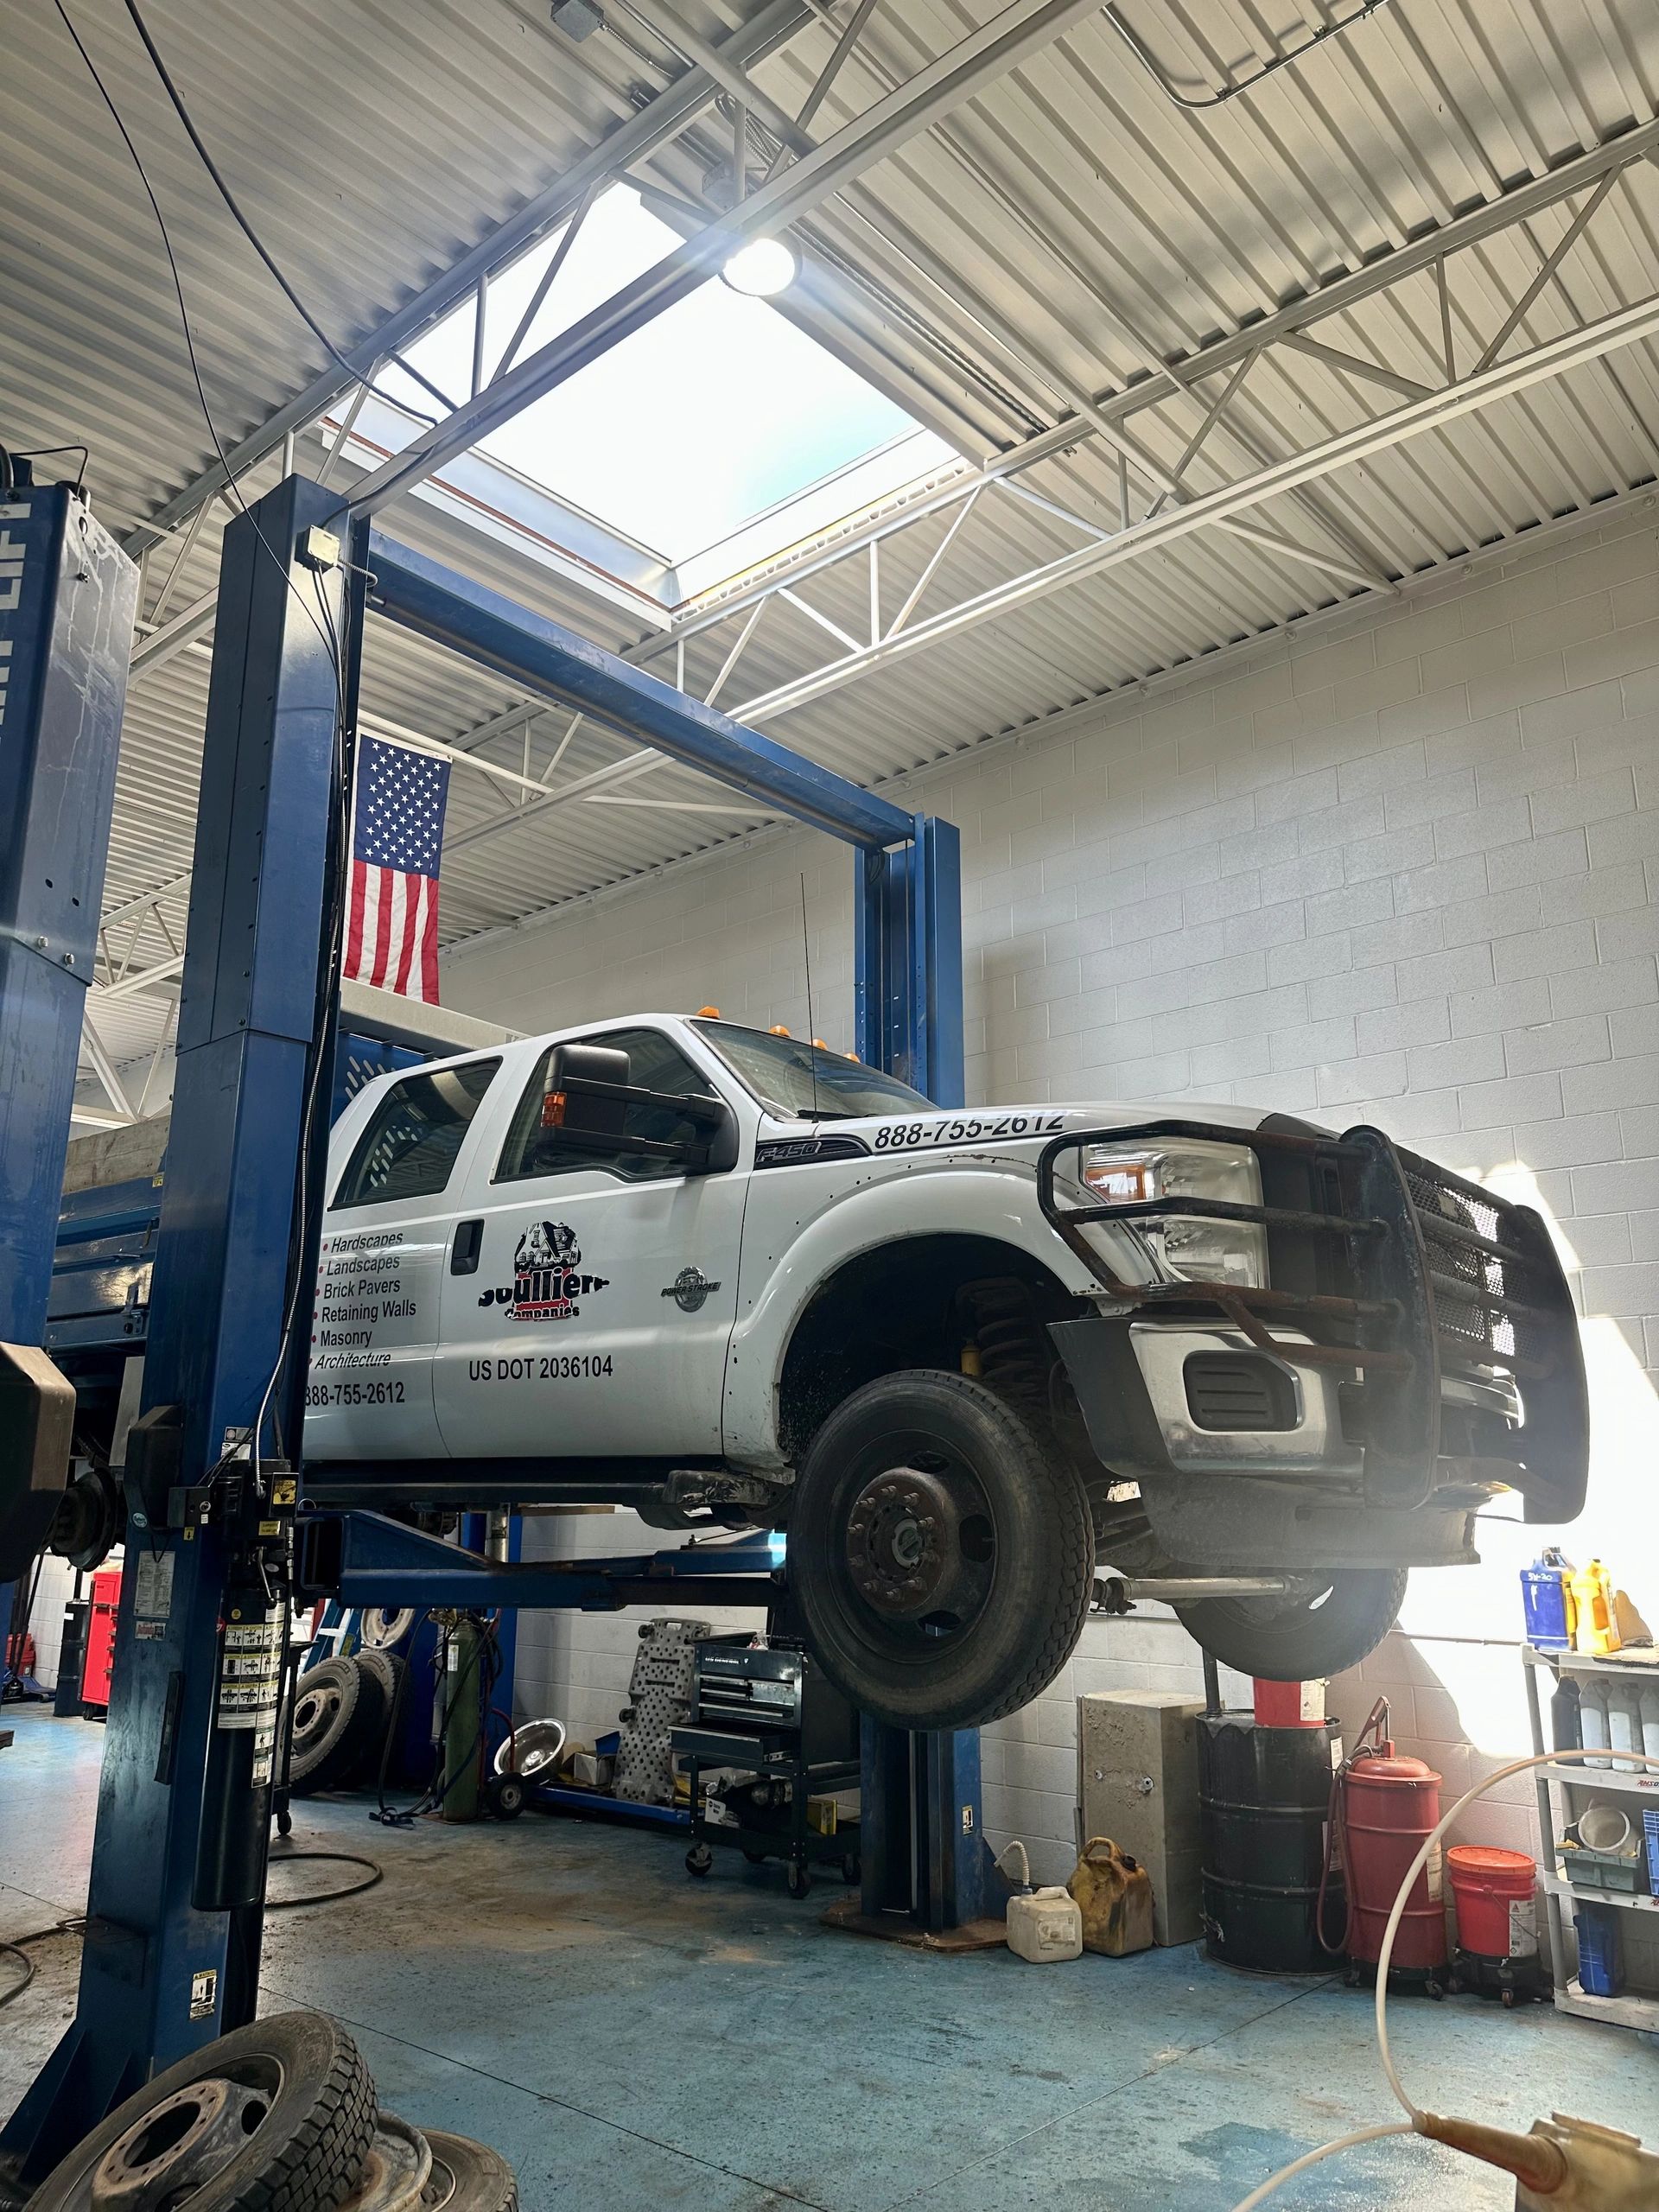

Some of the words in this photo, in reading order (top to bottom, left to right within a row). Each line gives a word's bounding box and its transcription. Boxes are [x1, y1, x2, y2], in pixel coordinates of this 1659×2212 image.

[874, 1111, 1067, 1149] 888-755-2612
[331, 1232, 404, 1253] Hardscapes
[327, 1256, 400, 1275] Landscapes
[324, 1281, 355, 1299] Brick
[358, 1280, 401, 1296] Pavers
[321, 1304, 378, 1323] Retaining
[383, 1300, 416, 1318] Walls
[321, 1331, 372, 1348] Masonry
[315, 1353, 391, 1370] Architecture
[469, 1360, 492, 1381] US
[498, 1358, 535, 1380] DOT
[539, 1355, 613, 1379] 2036104
